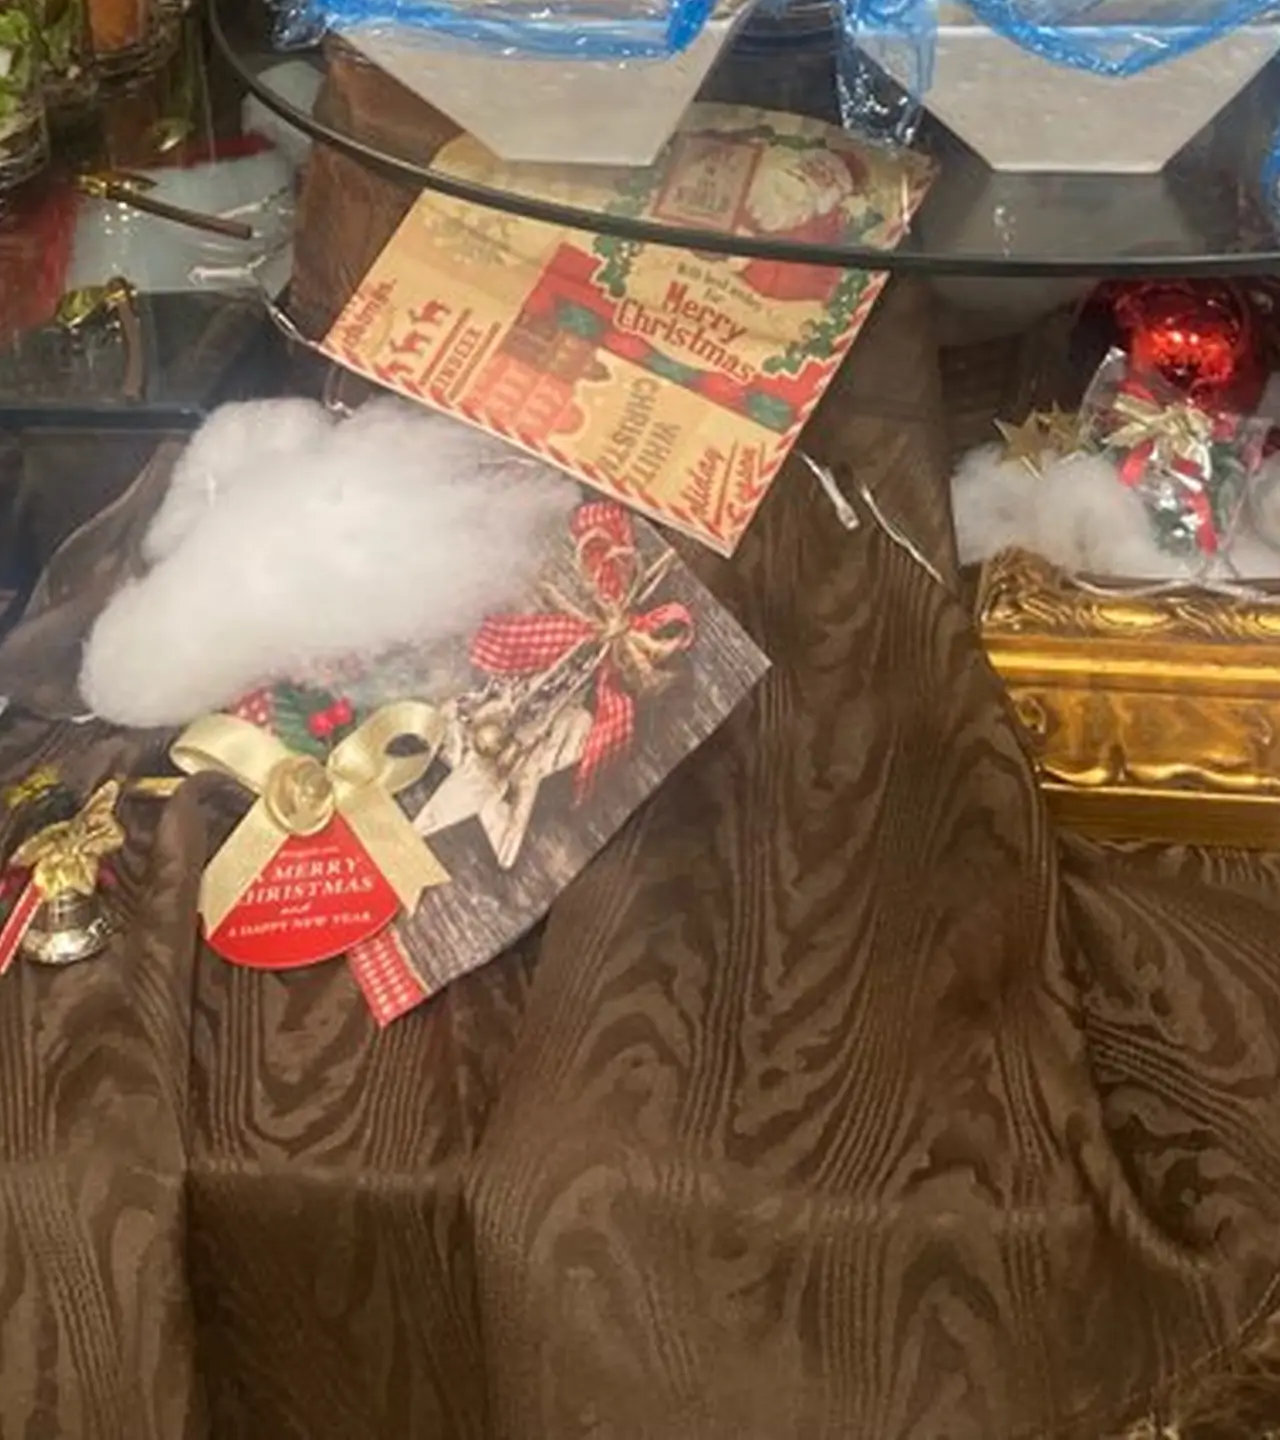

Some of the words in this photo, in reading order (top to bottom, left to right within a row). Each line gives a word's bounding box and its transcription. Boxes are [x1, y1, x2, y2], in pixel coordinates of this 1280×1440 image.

[661, 280, 748, 345] Merry
[616, 297, 756, 381] Christmas
[274, 858, 359, 880] MERRY
[243, 875, 375, 904] HRISTMAS
[240, 920, 288, 936] HAPPY
[292, 916, 327, 930] NEW
[331, 910, 371, 925] YEAR
